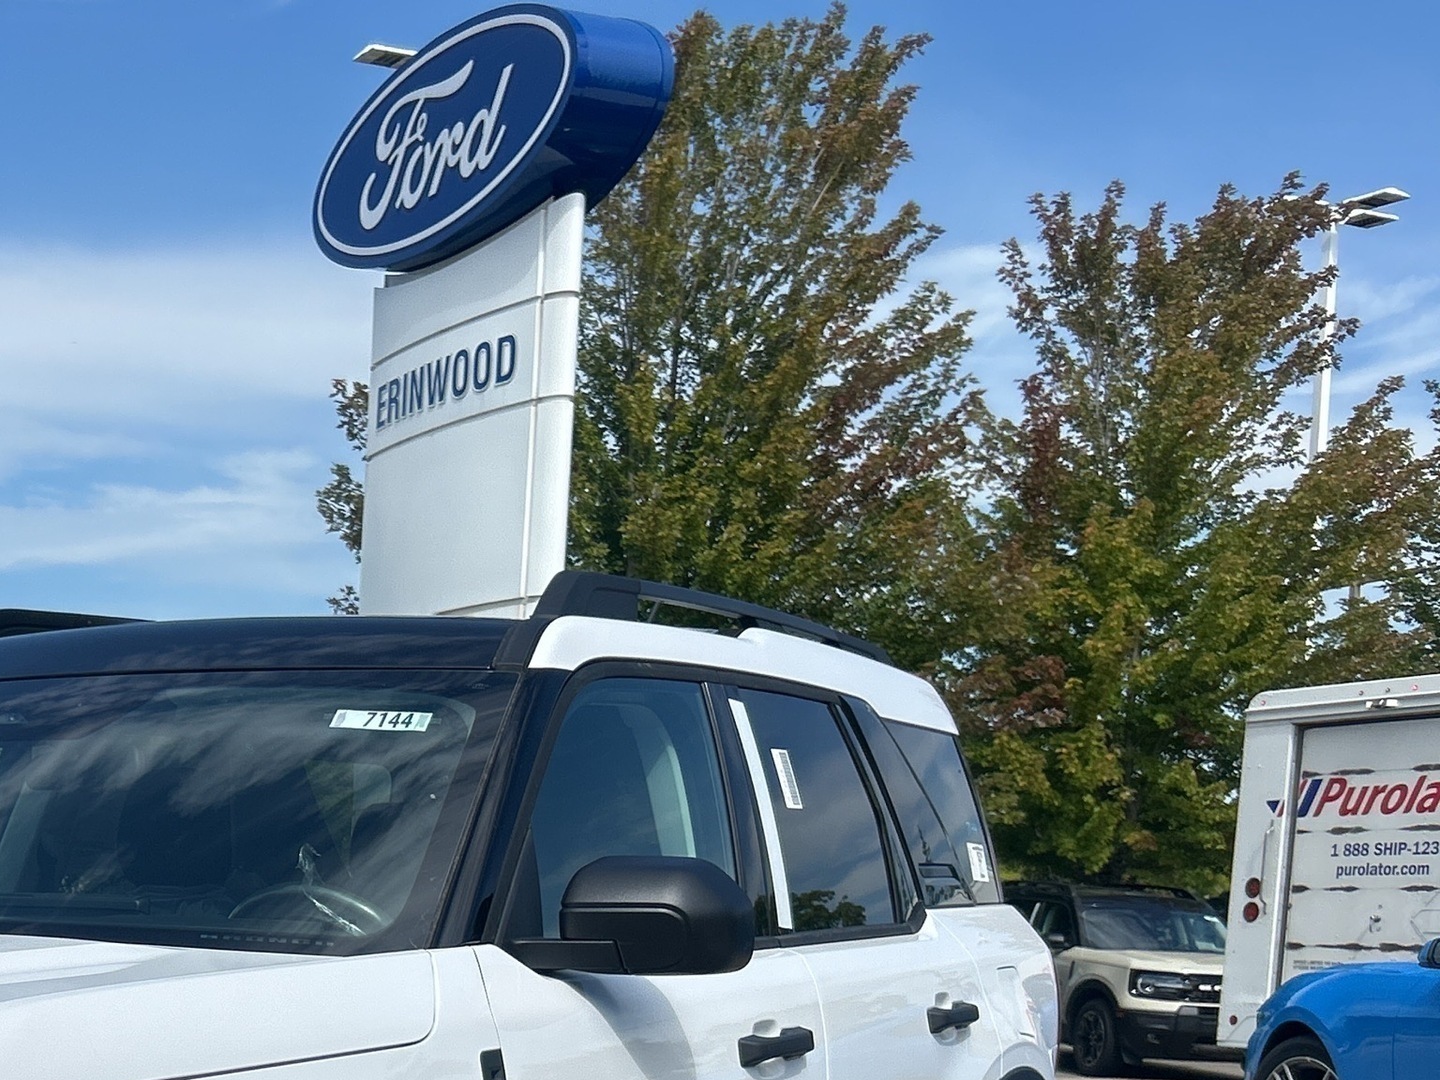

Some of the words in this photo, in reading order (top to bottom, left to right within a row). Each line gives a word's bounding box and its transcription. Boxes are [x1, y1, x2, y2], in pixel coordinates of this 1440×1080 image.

[358, 58, 515, 231] Ford
[376, 333, 517, 431] ERINWOOD
[363, 711, 415, 729] 7144
[1330, 843, 1339, 857] 1
[1343, 842, 1370, 857] 888
[1373, 840, 1440, 856] SHIP-123
[1336, 863, 1430, 879] purolator.com
